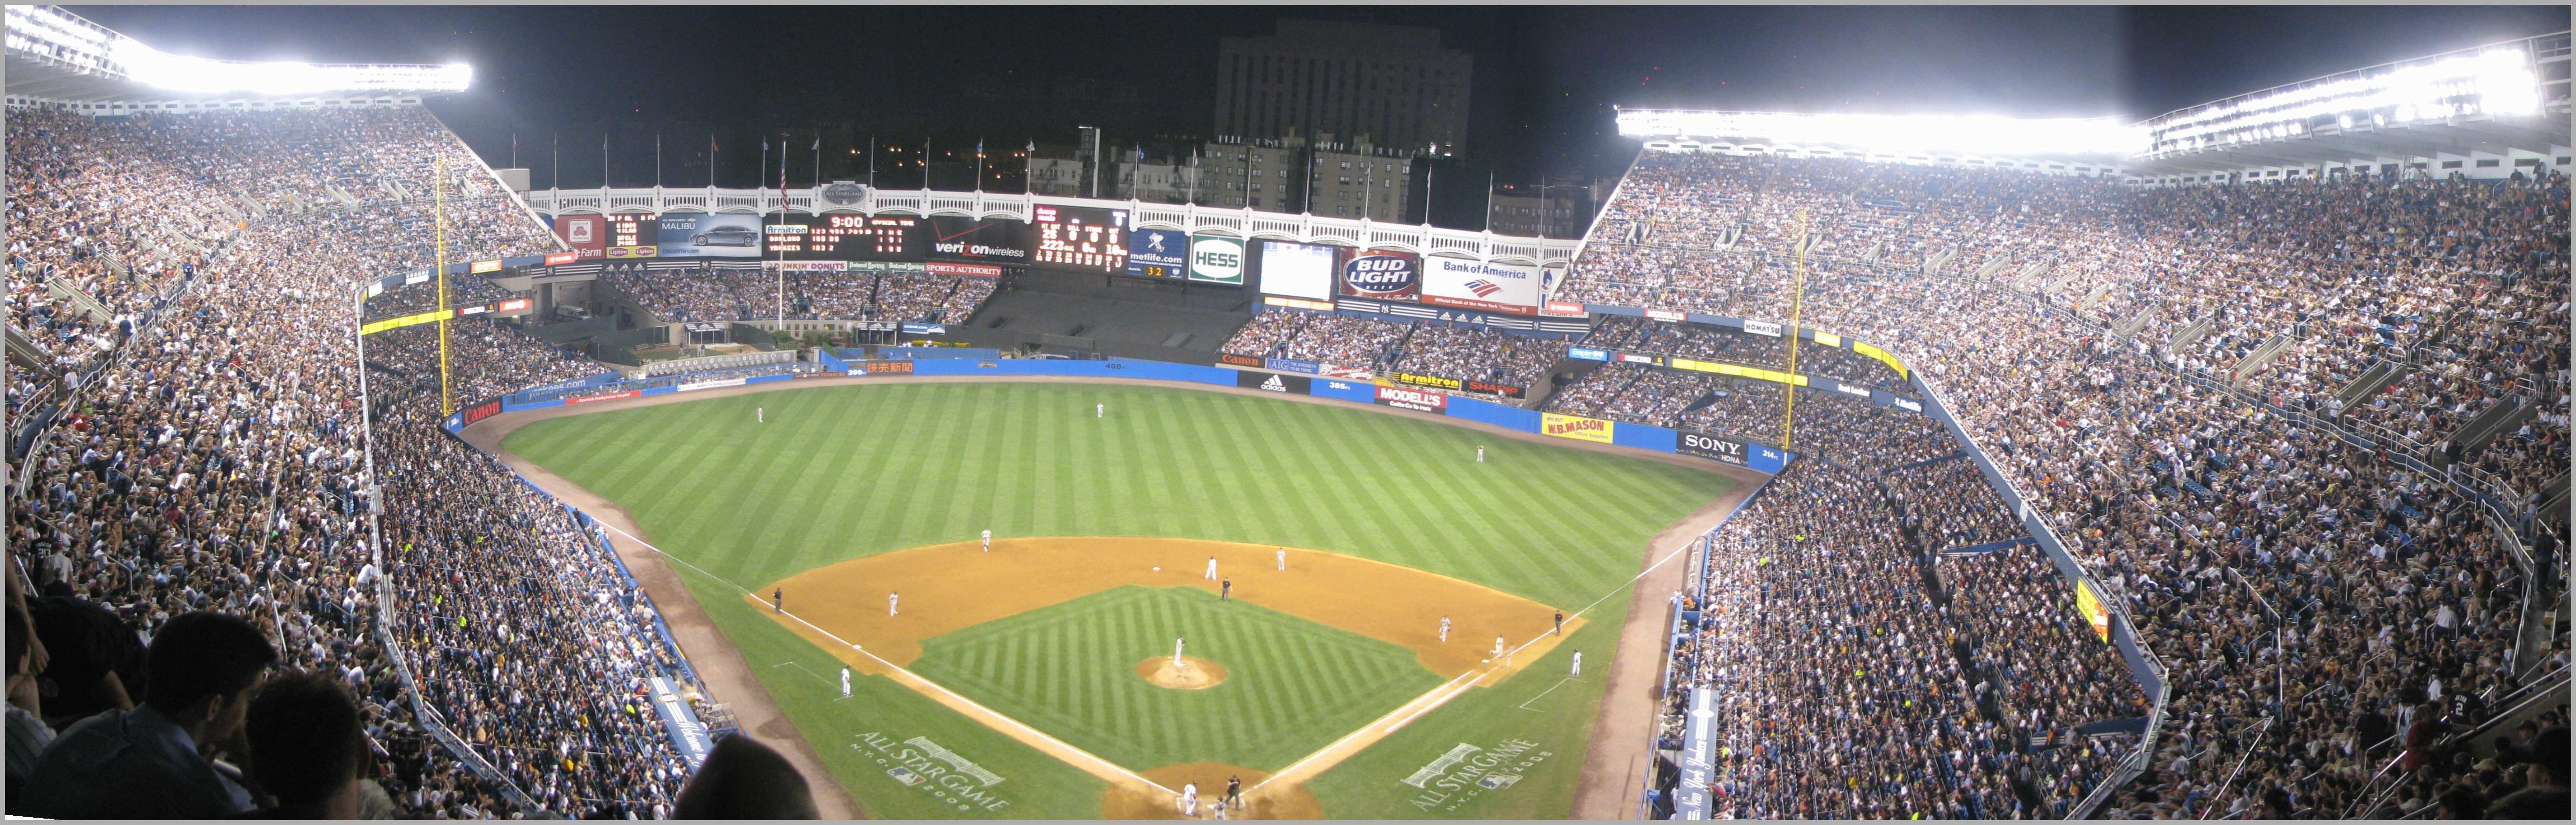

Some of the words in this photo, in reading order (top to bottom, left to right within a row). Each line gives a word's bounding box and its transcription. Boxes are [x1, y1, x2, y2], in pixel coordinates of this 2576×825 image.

[832, 217, 863, 227] 9:00
[1130, 253, 1182, 263] metlife.com
[1196, 251, 1238, 268] HESS
[868, 262, 885, 270] Spring
[907, 262, 924, 271] Spring
[957, 266, 1001, 275] AUTHORITY
[1357, 259, 1405, 271] BUD
[1444, 261, 1469, 273] Bank
[1471, 265, 1481, 274] of
[1349, 271, 1411, 283] LIGHT
[1745, 323, 1780, 334] KOMATSU
[1222, 354, 1260, 367] Canon
[1270, 360, 1288, 371] AIG
[1320, 366, 1363, 376] Budweiser
[1400, 373, 1459, 389] Armitron
[1261, 383, 1287, 392] adidas
[1380, 388, 1441, 406] MODELL'S
[464, 401, 500, 425] Canon
[1685, 434, 1740, 455] SONY
[1721, 454, 1740, 464] HDNA
[1762, 450, 1774, 459] 314
[2456, 702, 2463, 716] 2
[1686, 740, 1712, 770] Yankees
[855, 732, 896, 753] ALL
[890, 748, 946, 779] STAR
[940, 774, 1010, 811] GAME
[1683, 768, 1711, 792] York
[1410, 789, 1451, 813] ALL
[1436, 766, 1482, 792] STAR
[1682, 792, 1703, 812] New
